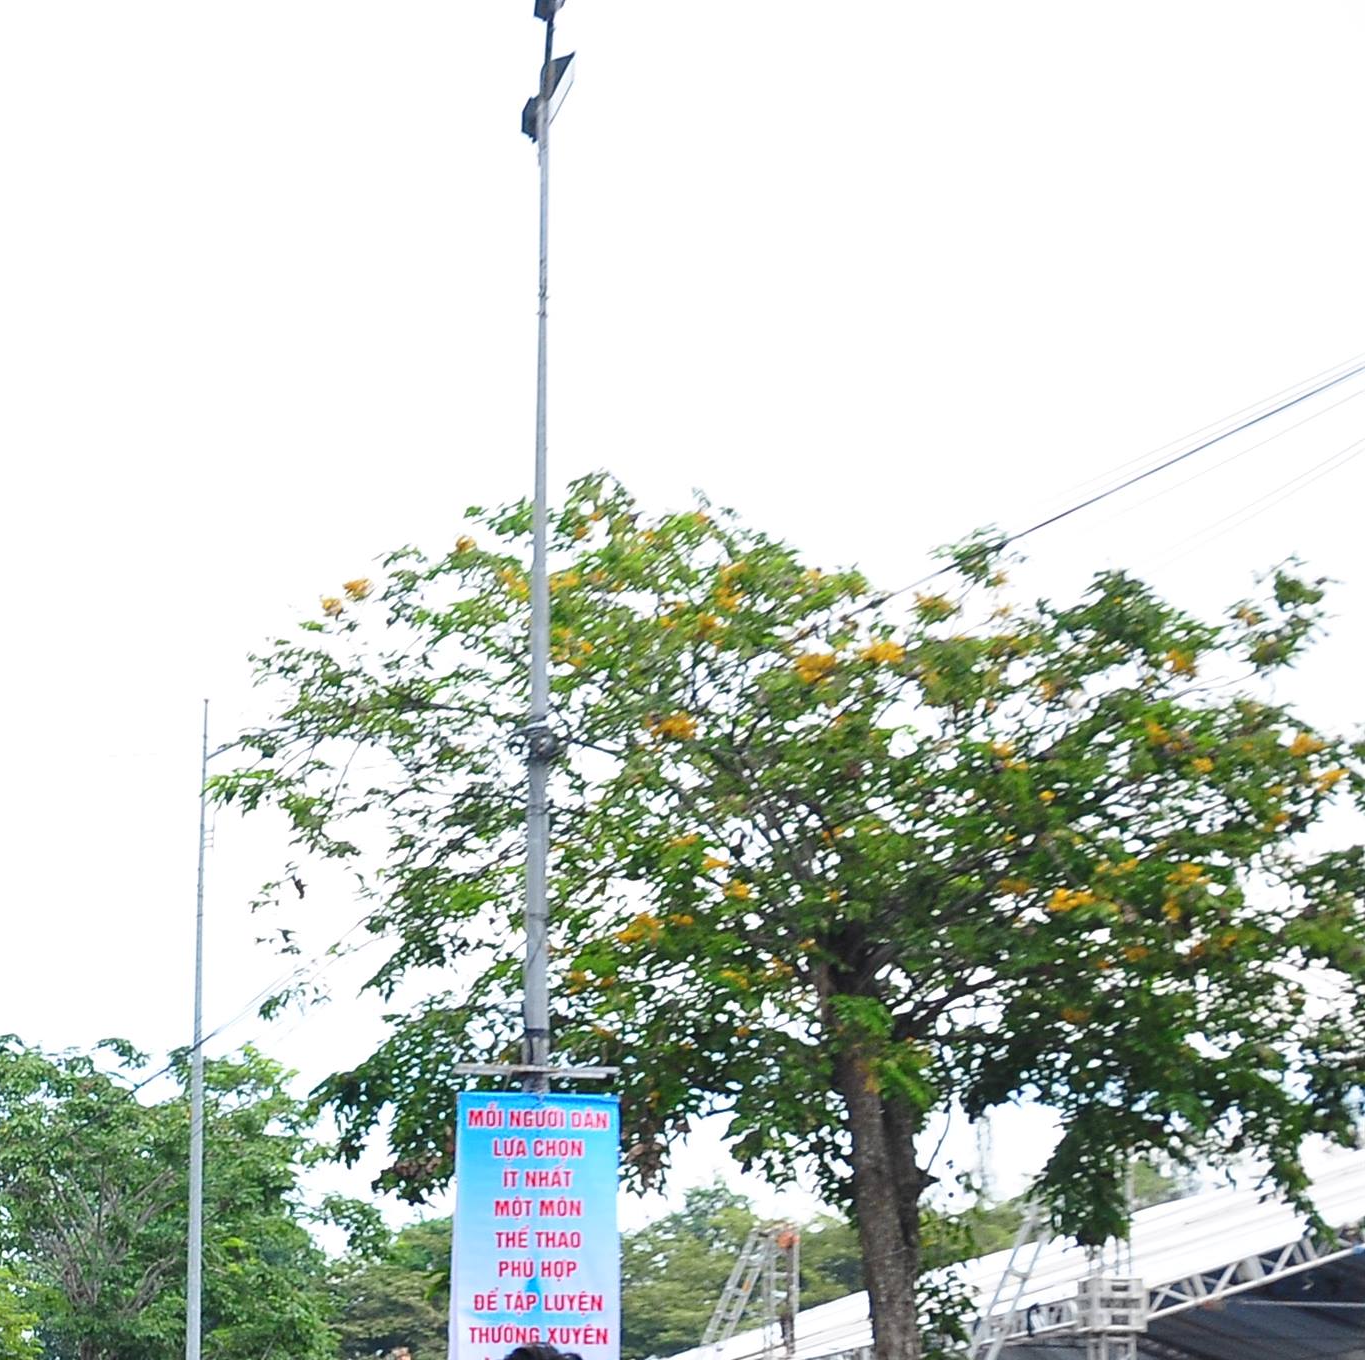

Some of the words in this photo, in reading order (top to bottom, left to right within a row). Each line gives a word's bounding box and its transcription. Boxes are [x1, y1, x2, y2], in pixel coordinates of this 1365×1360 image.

[571, 1109, 608, 1129] DÂN
[493, 1138, 527, 1160] LỰA
[533, 1140, 583, 1160] CHỌN
[494, 1197, 532, 1220] MỘT
[539, 1196, 581, 1216] MÔN
[535, 1231, 581, 1248] THAO
[540, 1260, 577, 1281] HỢP
[473, 1287, 498, 1310] ĐỂ
[504, 1291, 537, 1315] TẬP
[544, 1291, 603, 1315] LUYỆN
[469, 1324, 539, 1344] THƯỜNG
[548, 1324, 608, 1345] XUYÊN
